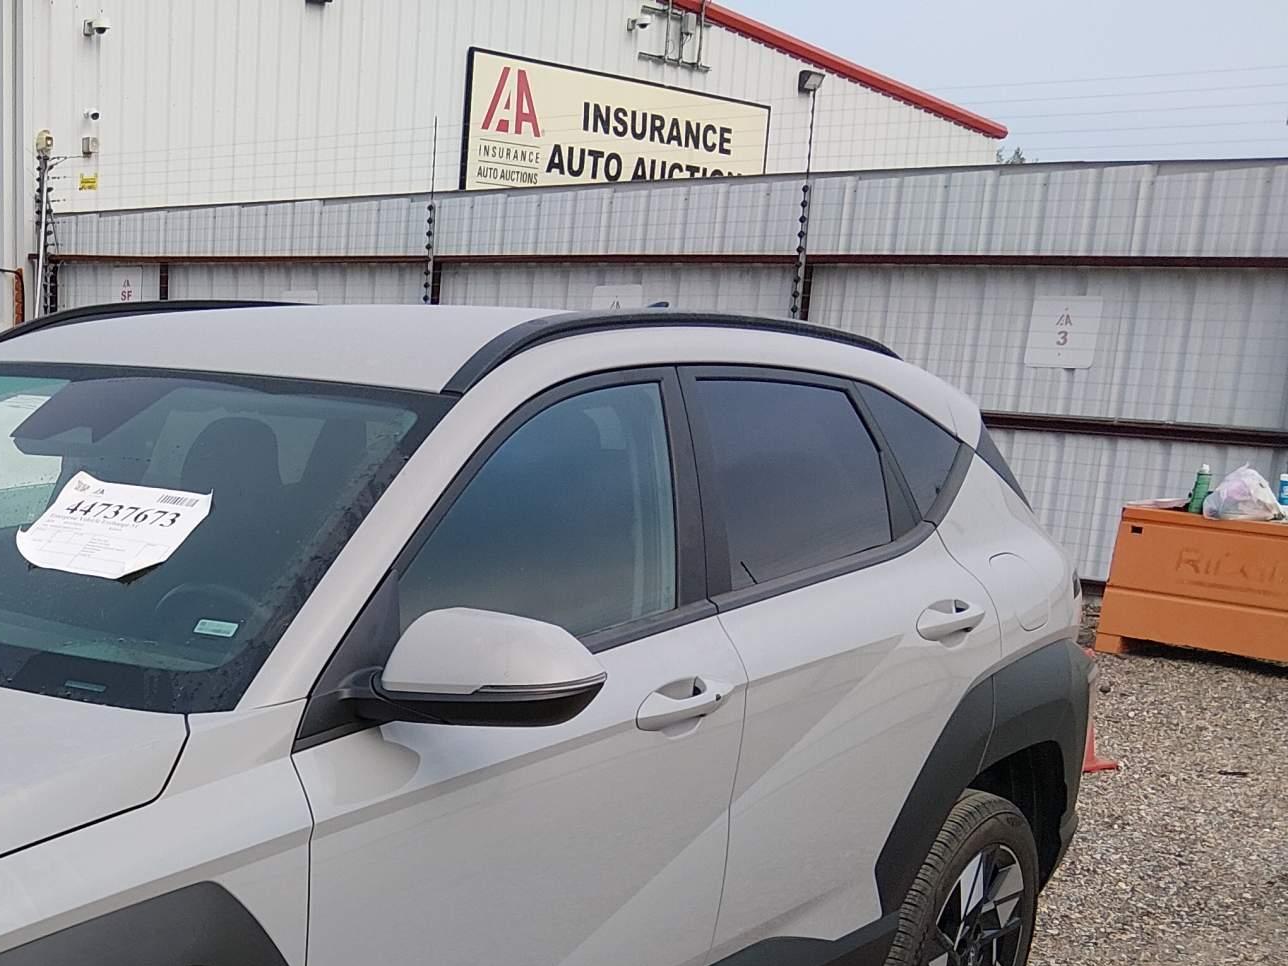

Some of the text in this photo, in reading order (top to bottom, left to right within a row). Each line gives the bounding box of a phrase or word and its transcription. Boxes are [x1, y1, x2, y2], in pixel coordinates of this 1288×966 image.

[582, 101, 732, 155] INSURANCE
[478, 144, 540, 164] INSURANCE
[546, 144, 623, 182] AUTO
[477, 165, 538, 185] AUTO AUCTIONS
[121, 290, 132, 301] SF
[1056, 330, 1069, 346] 3
[66, 499, 182, 528] 44737673
